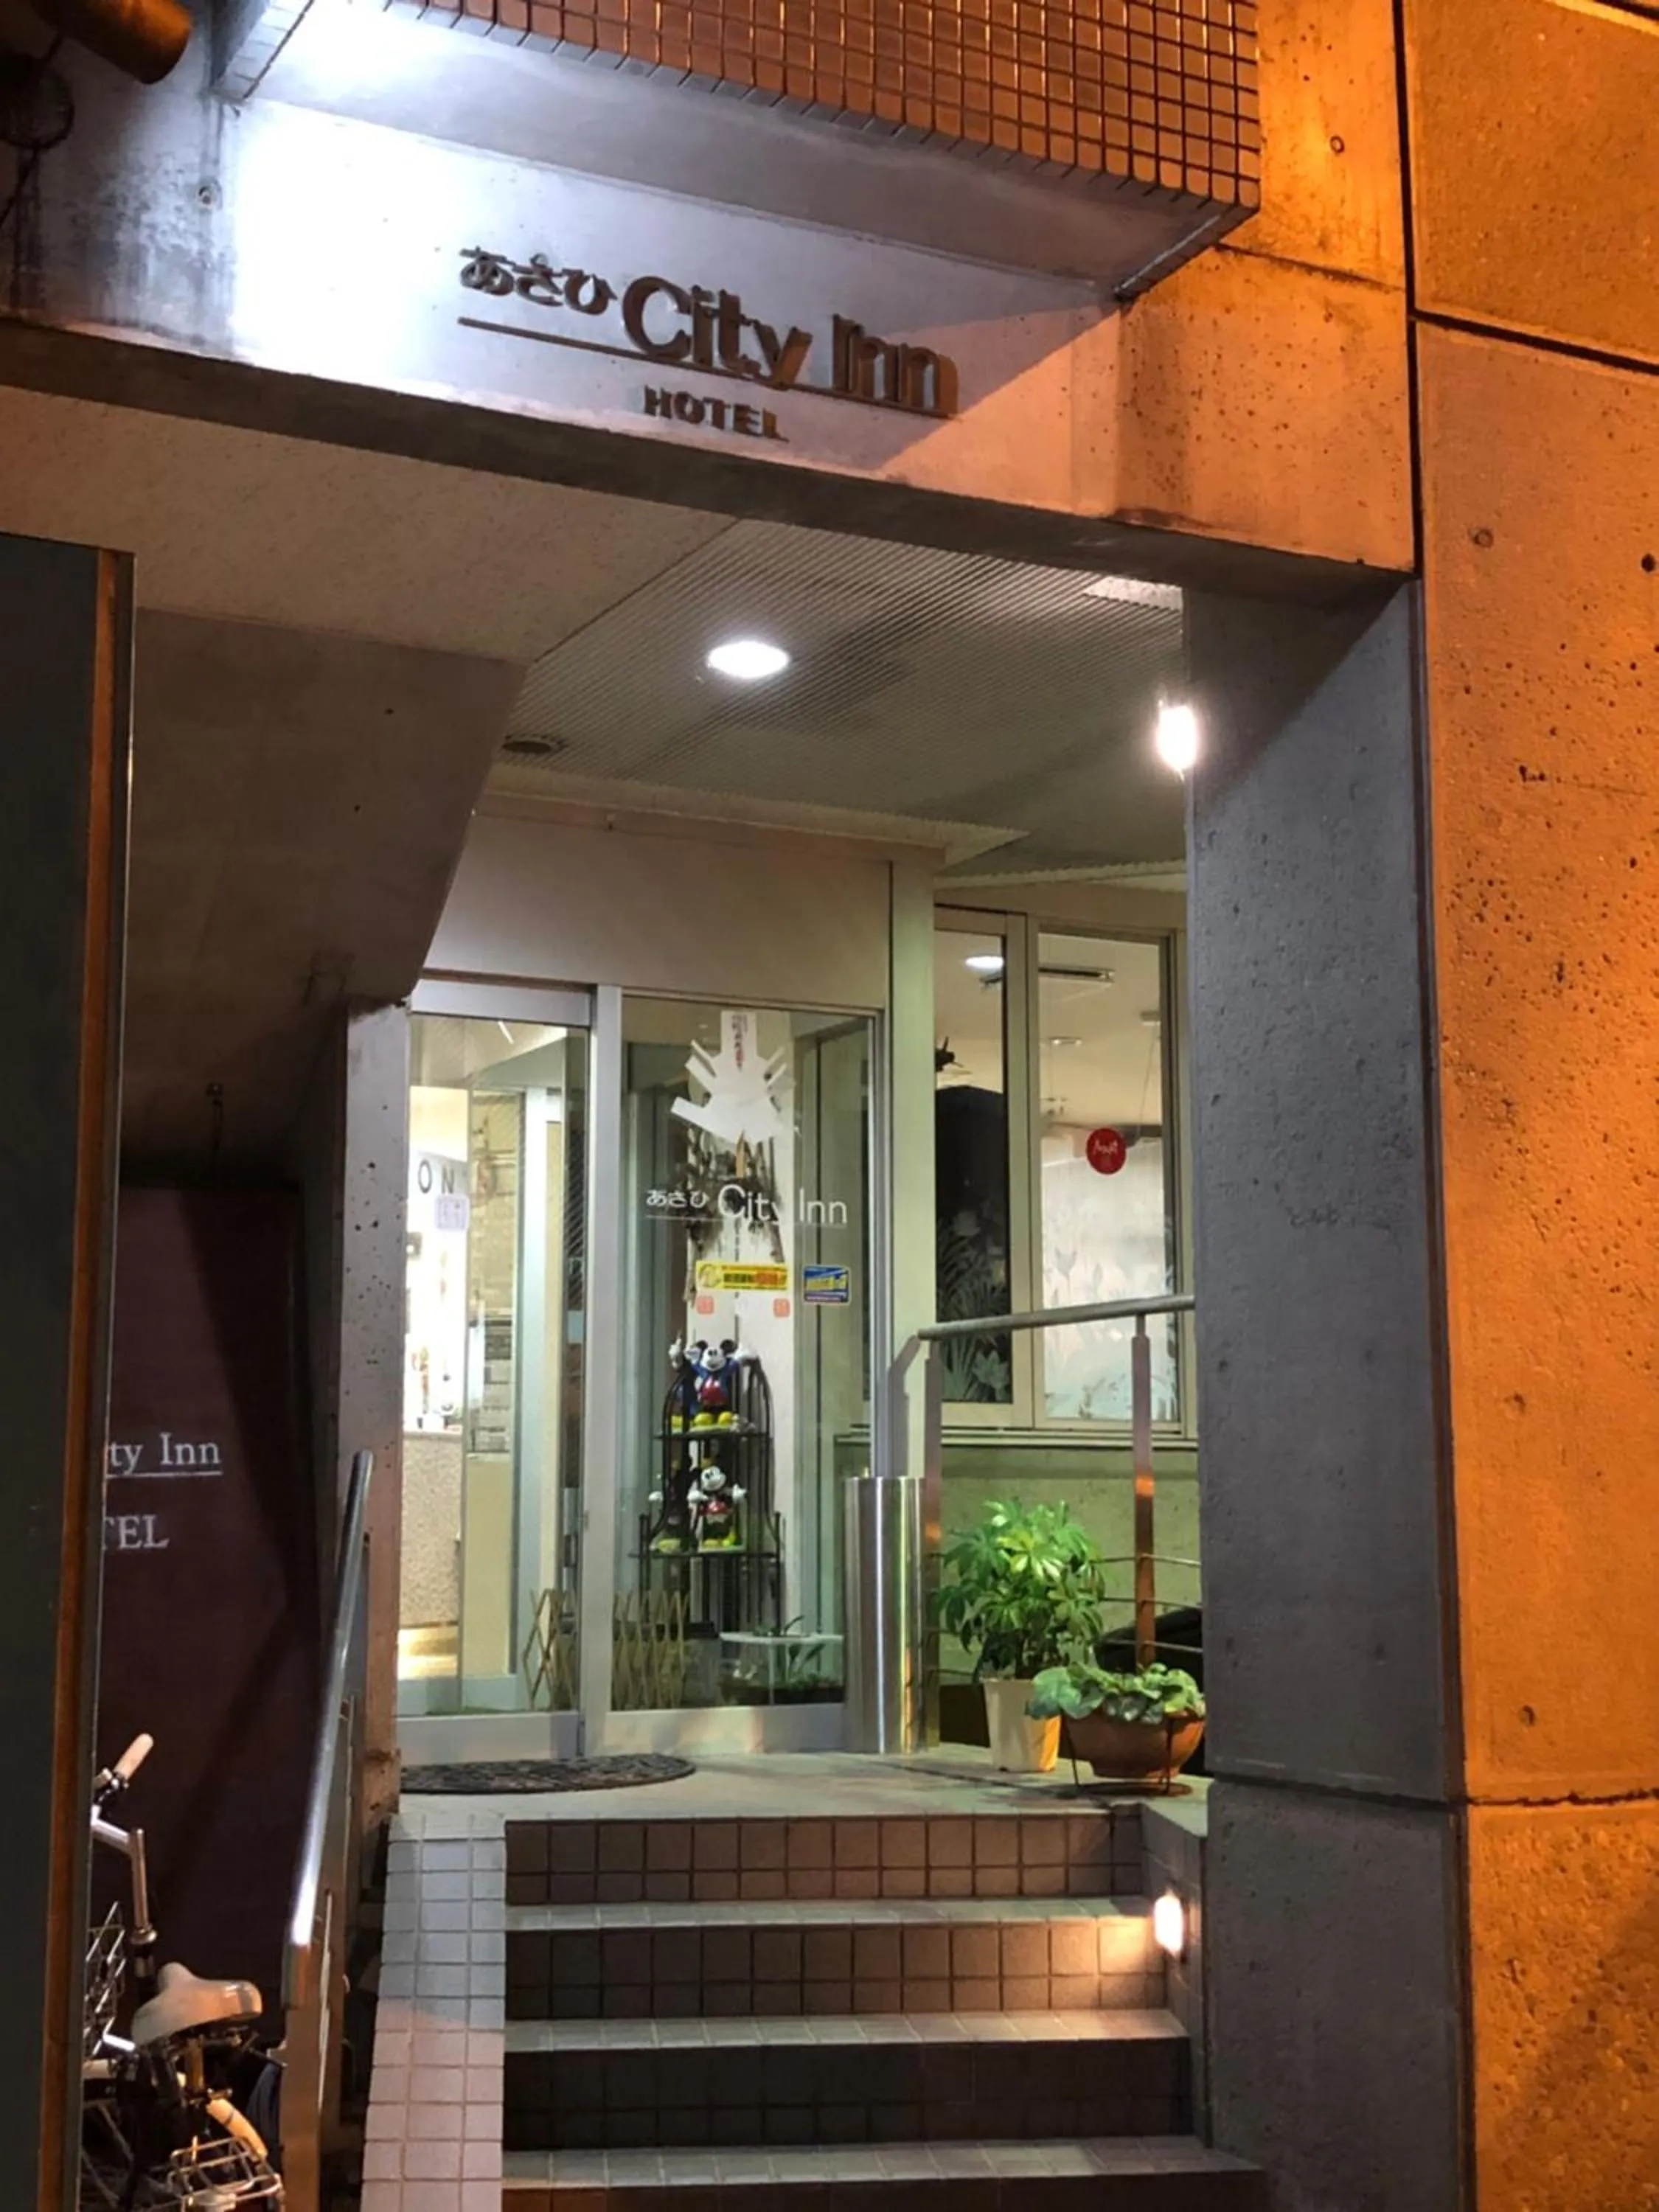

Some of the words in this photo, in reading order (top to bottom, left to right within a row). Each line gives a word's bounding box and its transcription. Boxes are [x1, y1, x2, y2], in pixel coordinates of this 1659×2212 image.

[459, 246, 617, 316] あさひ
[621, 276, 813, 391] City
[832, 313, 960, 418] Inn
[644, 385, 789, 442] HOTEL
[646, 1189, 709, 1208] あさひ
[799, 1187, 847, 1224] Inn
[160, 1432, 221, 1464] Inn
